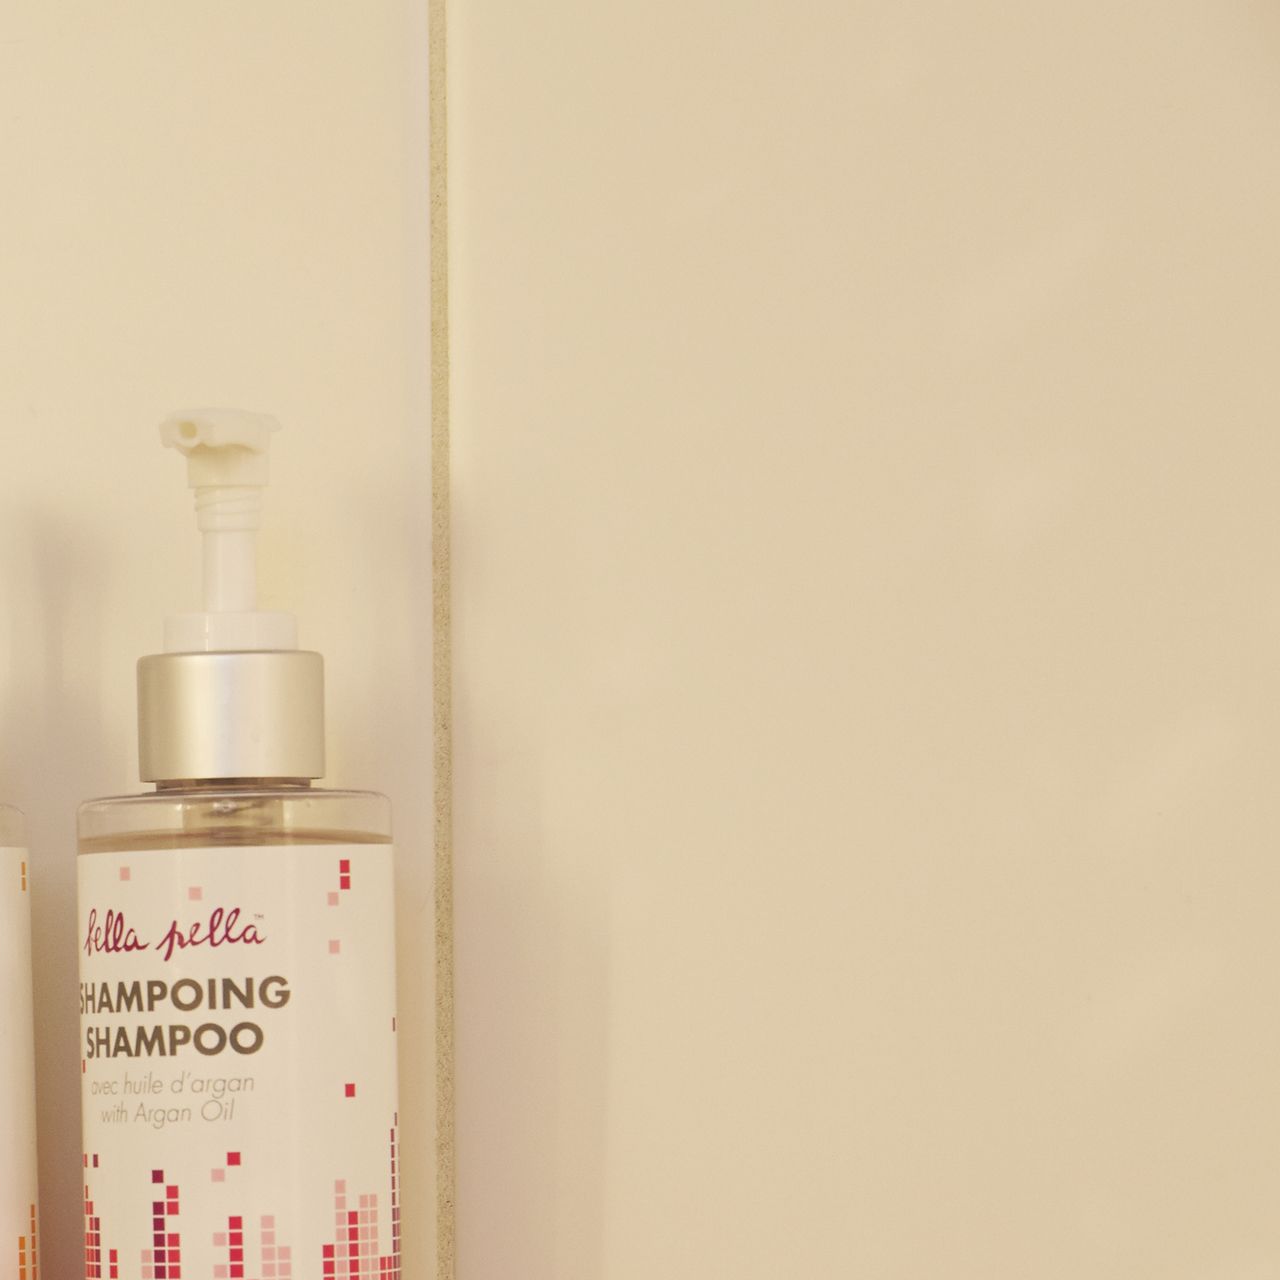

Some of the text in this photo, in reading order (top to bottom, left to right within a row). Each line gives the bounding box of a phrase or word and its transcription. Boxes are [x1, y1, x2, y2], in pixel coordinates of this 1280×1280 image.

[155, 907, 267, 961] pella
[81, 976, 290, 1015] SHAMPOING
[87, 1022, 264, 1058] SHAMPOO
[91, 1071, 255, 1100] avec huile d'argan
[101, 1099, 234, 1129] with Argan Oil
